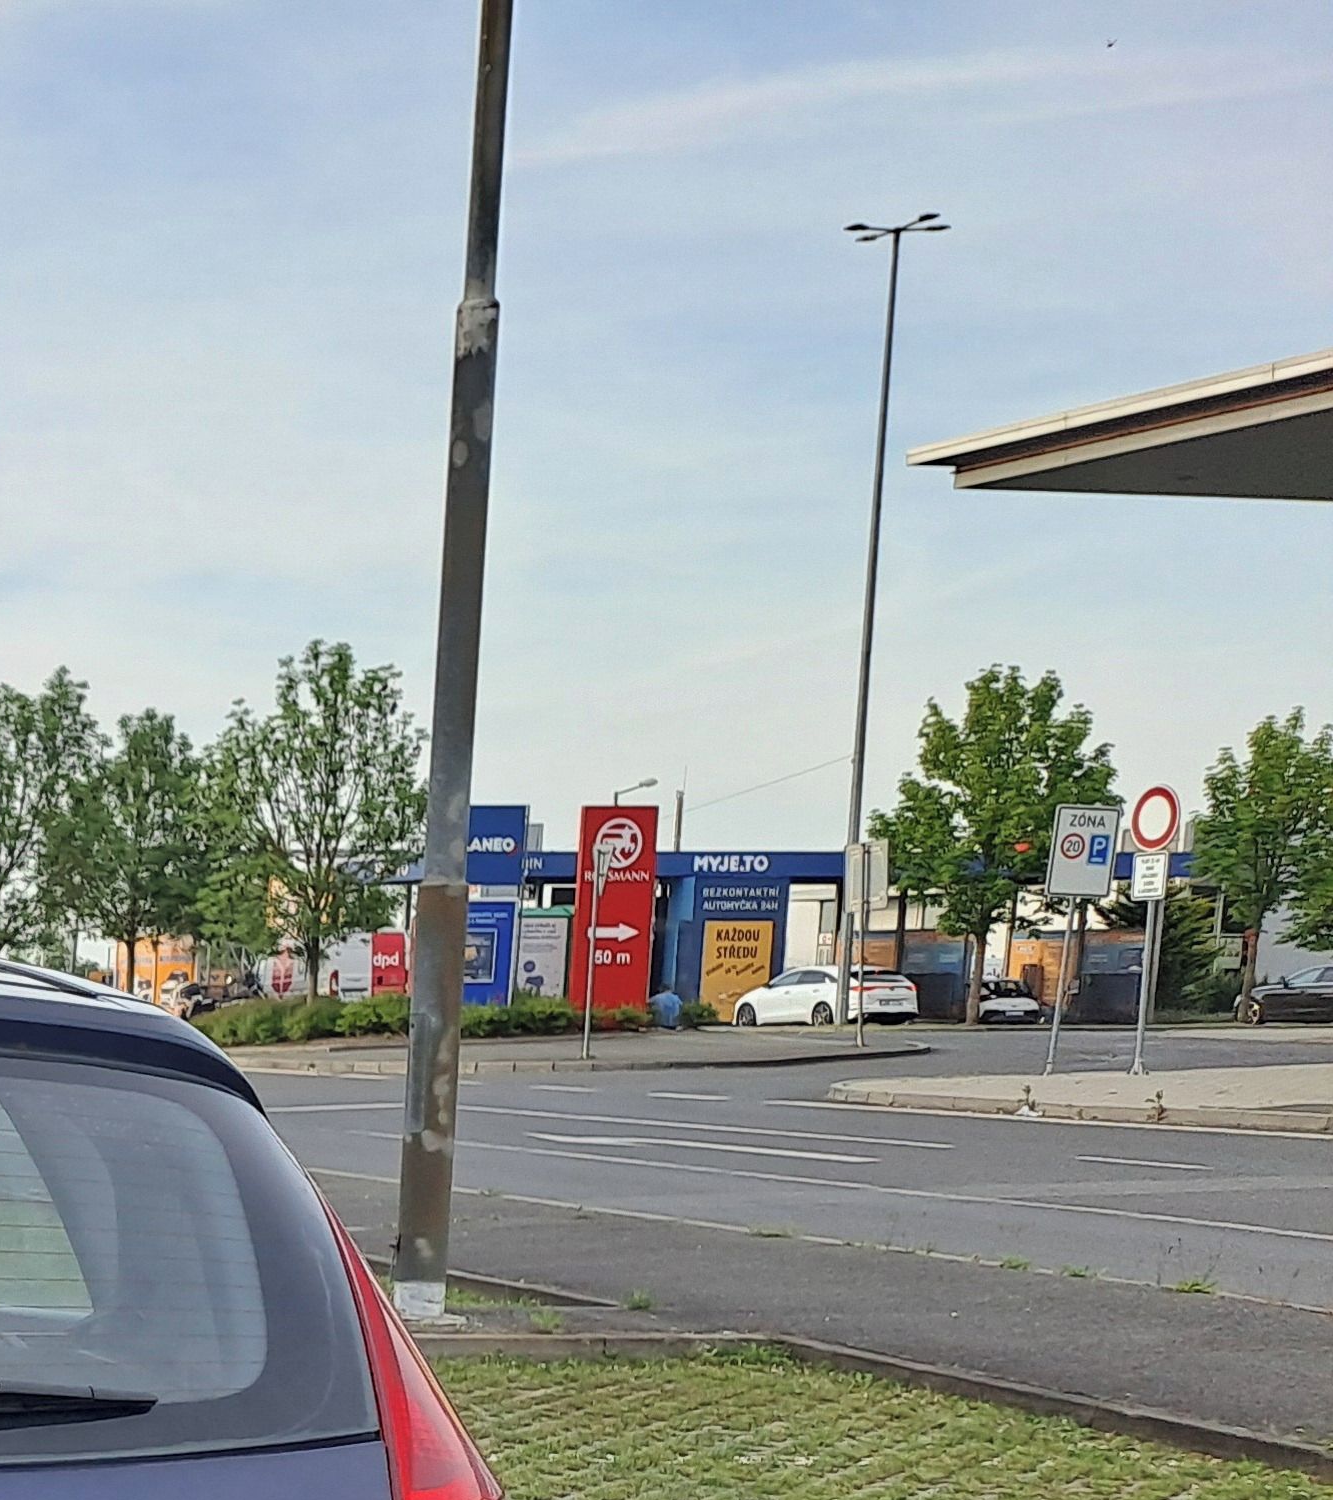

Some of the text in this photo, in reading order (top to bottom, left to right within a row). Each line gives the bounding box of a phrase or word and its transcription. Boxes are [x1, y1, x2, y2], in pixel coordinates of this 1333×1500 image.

[1069, 812, 1106, 828] ZÓNA
[467, 836, 516, 853] ANEO
[1065, 840, 1081, 852] 20
[693, 855, 769, 872] MYJE.TO
[584, 870, 650, 881] RSMANN
[716, 927, 761, 941] KAŽDOU
[594, 950, 631, 965] 50 m
[716, 944, 758, 959] STŘEDU
[373, 951, 399, 969] dpd
